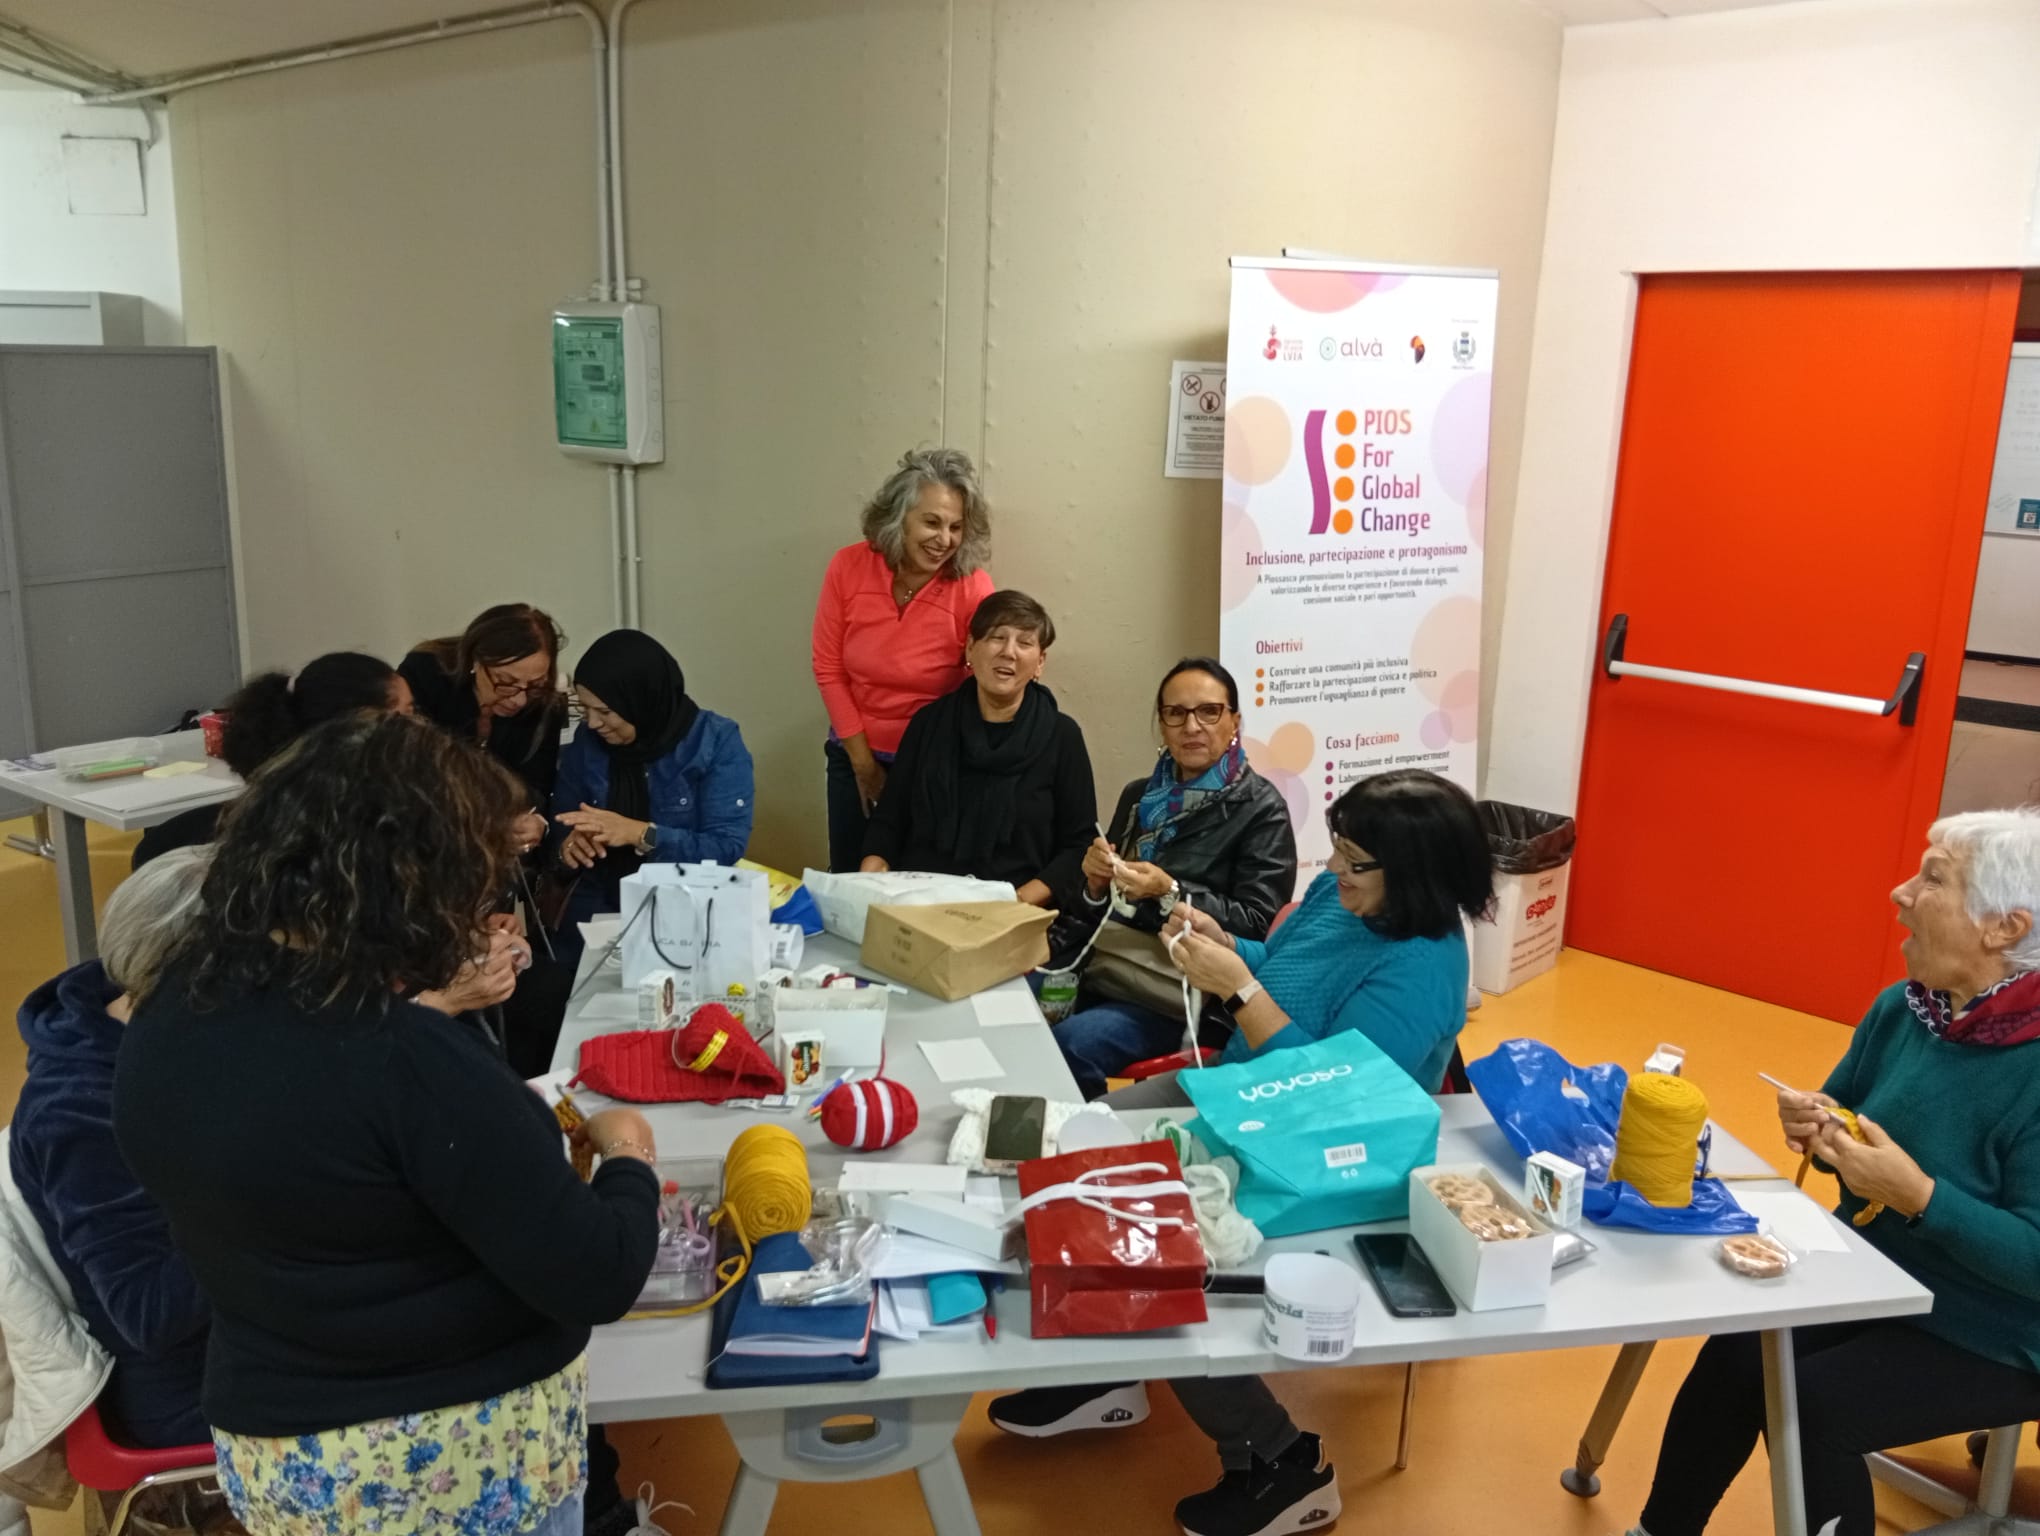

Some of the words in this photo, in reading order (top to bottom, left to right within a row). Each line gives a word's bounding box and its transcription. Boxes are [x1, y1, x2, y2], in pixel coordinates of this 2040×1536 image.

[1364, 409, 1412, 435] PIOS
[1363, 443, 1394, 468] For
[1362, 474, 1420, 500] Global
[1361, 507, 1431, 536] Change
[1245, 550, 1306, 566] Inclusione,
[1309, 546, 1385, 566] partecipazione
[1389, 549, 1395, 559] e
[1398, 543, 1468, 561] protagonismo
[1257, 574, 1263, 584] A
[1256, 638, 1303, 655] Obiettivi
[1269, 665, 1306, 677] Costruire
[1308, 665, 1323, 674] una
[1325, 660, 1361, 673] comunità
[1363, 659, 1374, 671] più
[1376, 656, 1408, 668] inclusiva
[1269, 679, 1311, 693] Rafforzare
[1313, 678, 1320, 687] la
[1322, 674, 1377, 689] partecipazione
[1379, 670, 1400, 681] civica
[1402, 672, 1407, 680] e
[1409, 667, 1437, 681] politica
[1269, 694, 1318, 706] Promuovere
[1371, 686, 1378, 696] di
[1380, 686, 1406, 698] genere
[1325, 735, 1352, 750] Cosa
[1355, 731, 1400, 751] facciamo
[1339, 757, 1382, 770] Formazione
[1384, 755, 1393, 765] ed
[1395, 750, 1450, 764] empowerment
